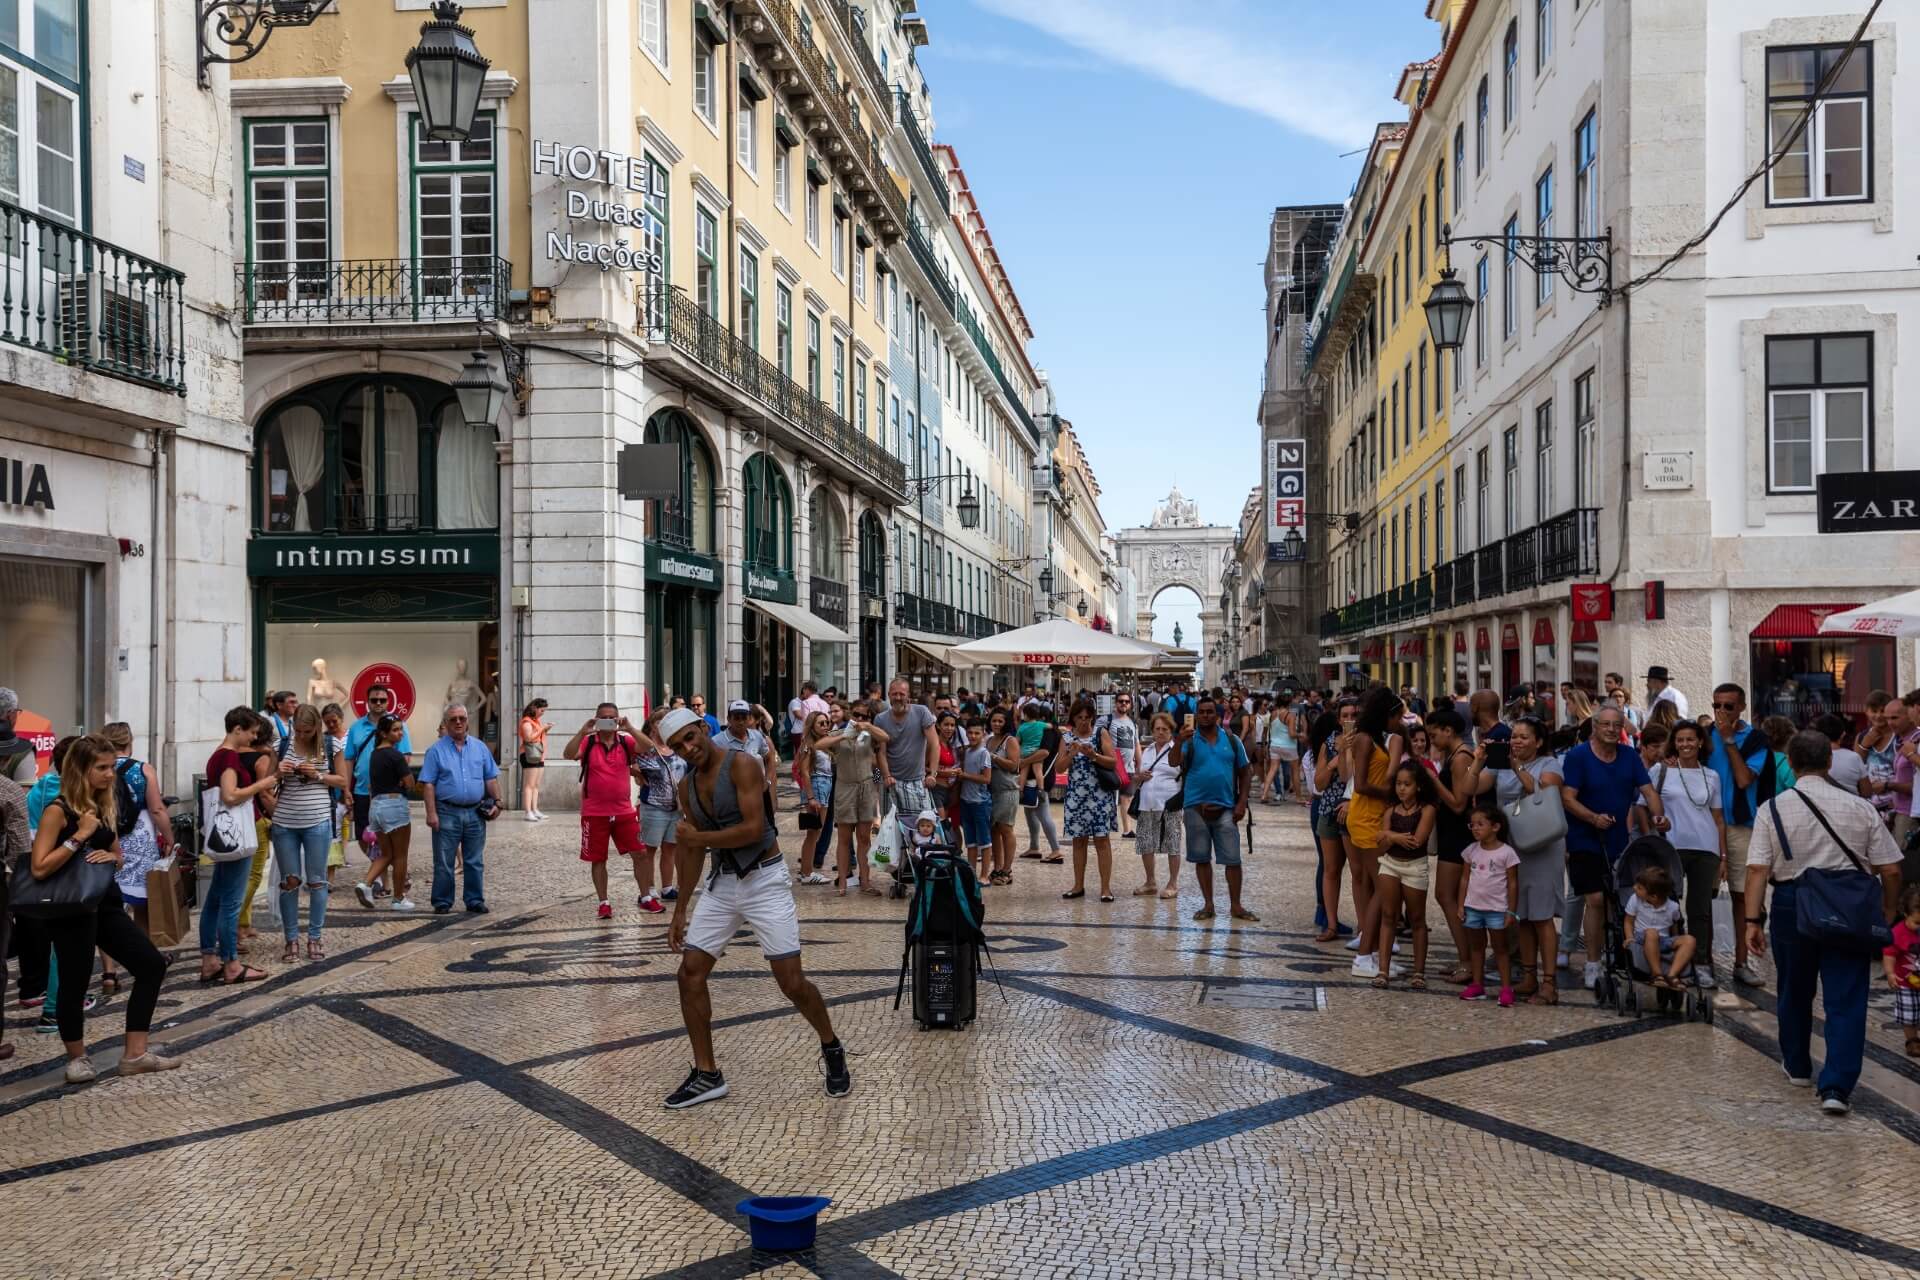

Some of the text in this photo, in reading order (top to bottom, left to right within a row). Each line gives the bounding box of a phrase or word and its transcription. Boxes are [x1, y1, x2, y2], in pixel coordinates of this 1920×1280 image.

[534, 139, 667, 199] HOTEL
[566, 189, 646, 229] Duas
[546, 231, 661, 273] Nações
[1832, 499, 1919, 520] ZAR
[276, 546, 470, 567] intimissimi
[1023, 654, 1054, 664] RED
[374, 673, 391, 684] ATÉ
